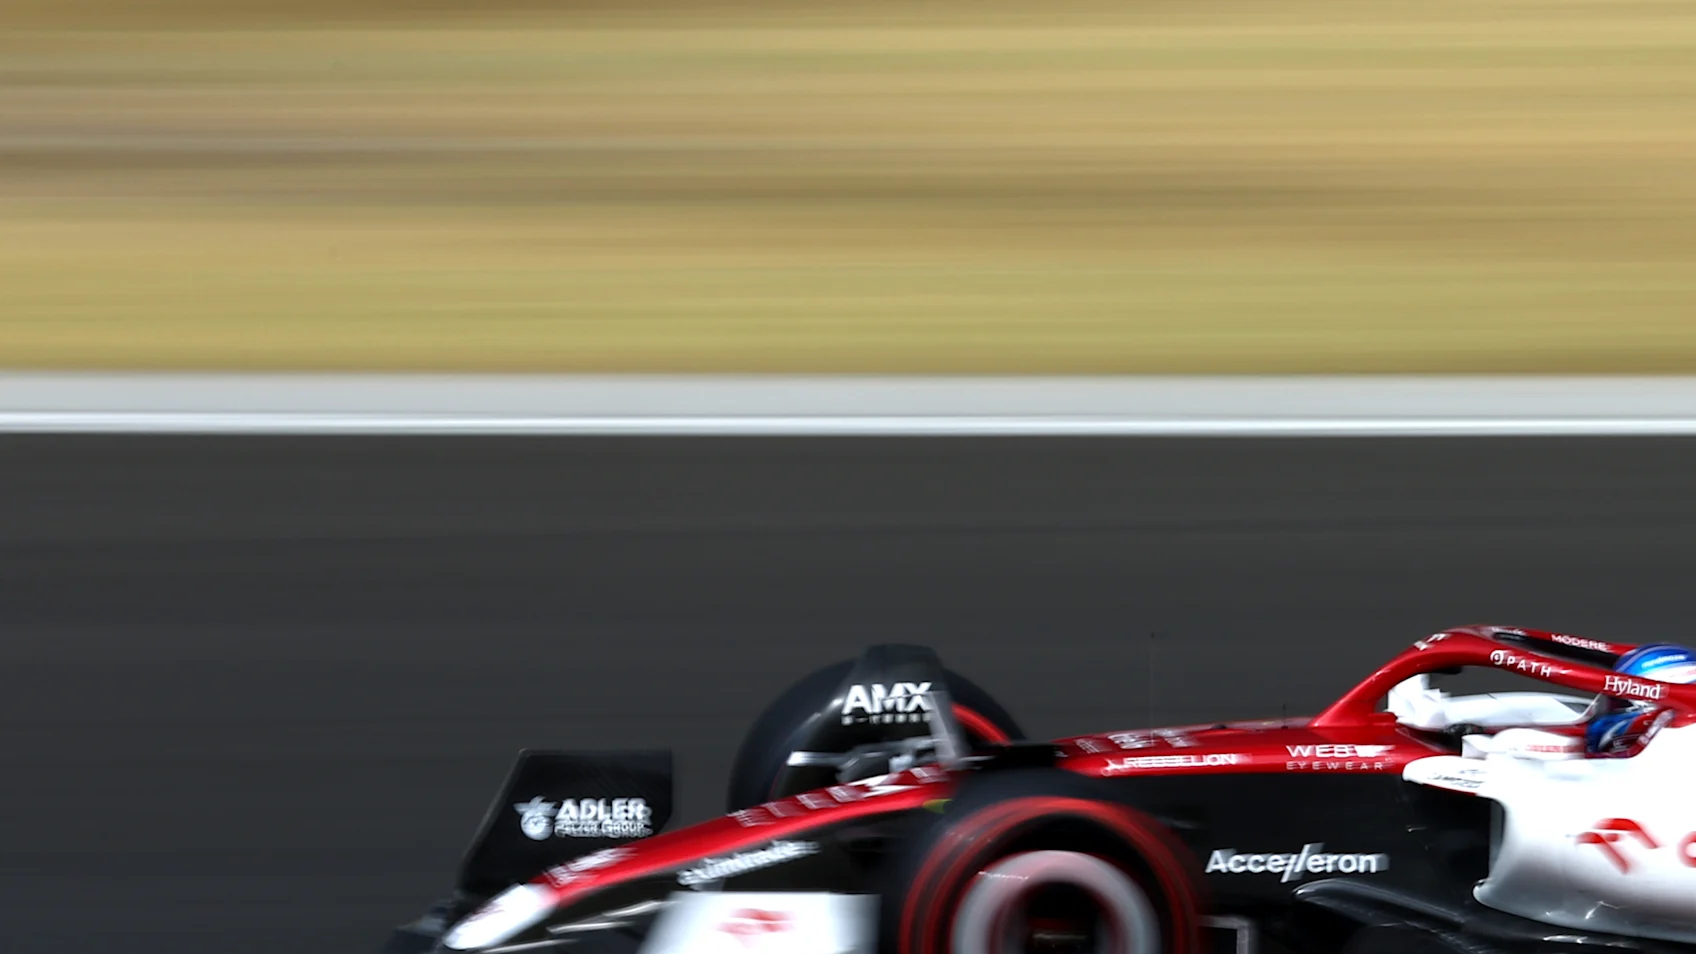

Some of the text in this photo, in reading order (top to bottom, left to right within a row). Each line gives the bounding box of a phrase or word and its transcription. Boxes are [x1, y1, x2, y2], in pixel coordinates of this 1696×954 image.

[1506, 655, 1552, 678] PATH
[842, 682, 932, 715] AMX
[1603, 675, 1662, 700] Hyland
[1123, 753, 1238, 769] REBELLION
[1286, 761, 1384, 771] EYEWEAR
[554, 798, 649, 821] ADLER
